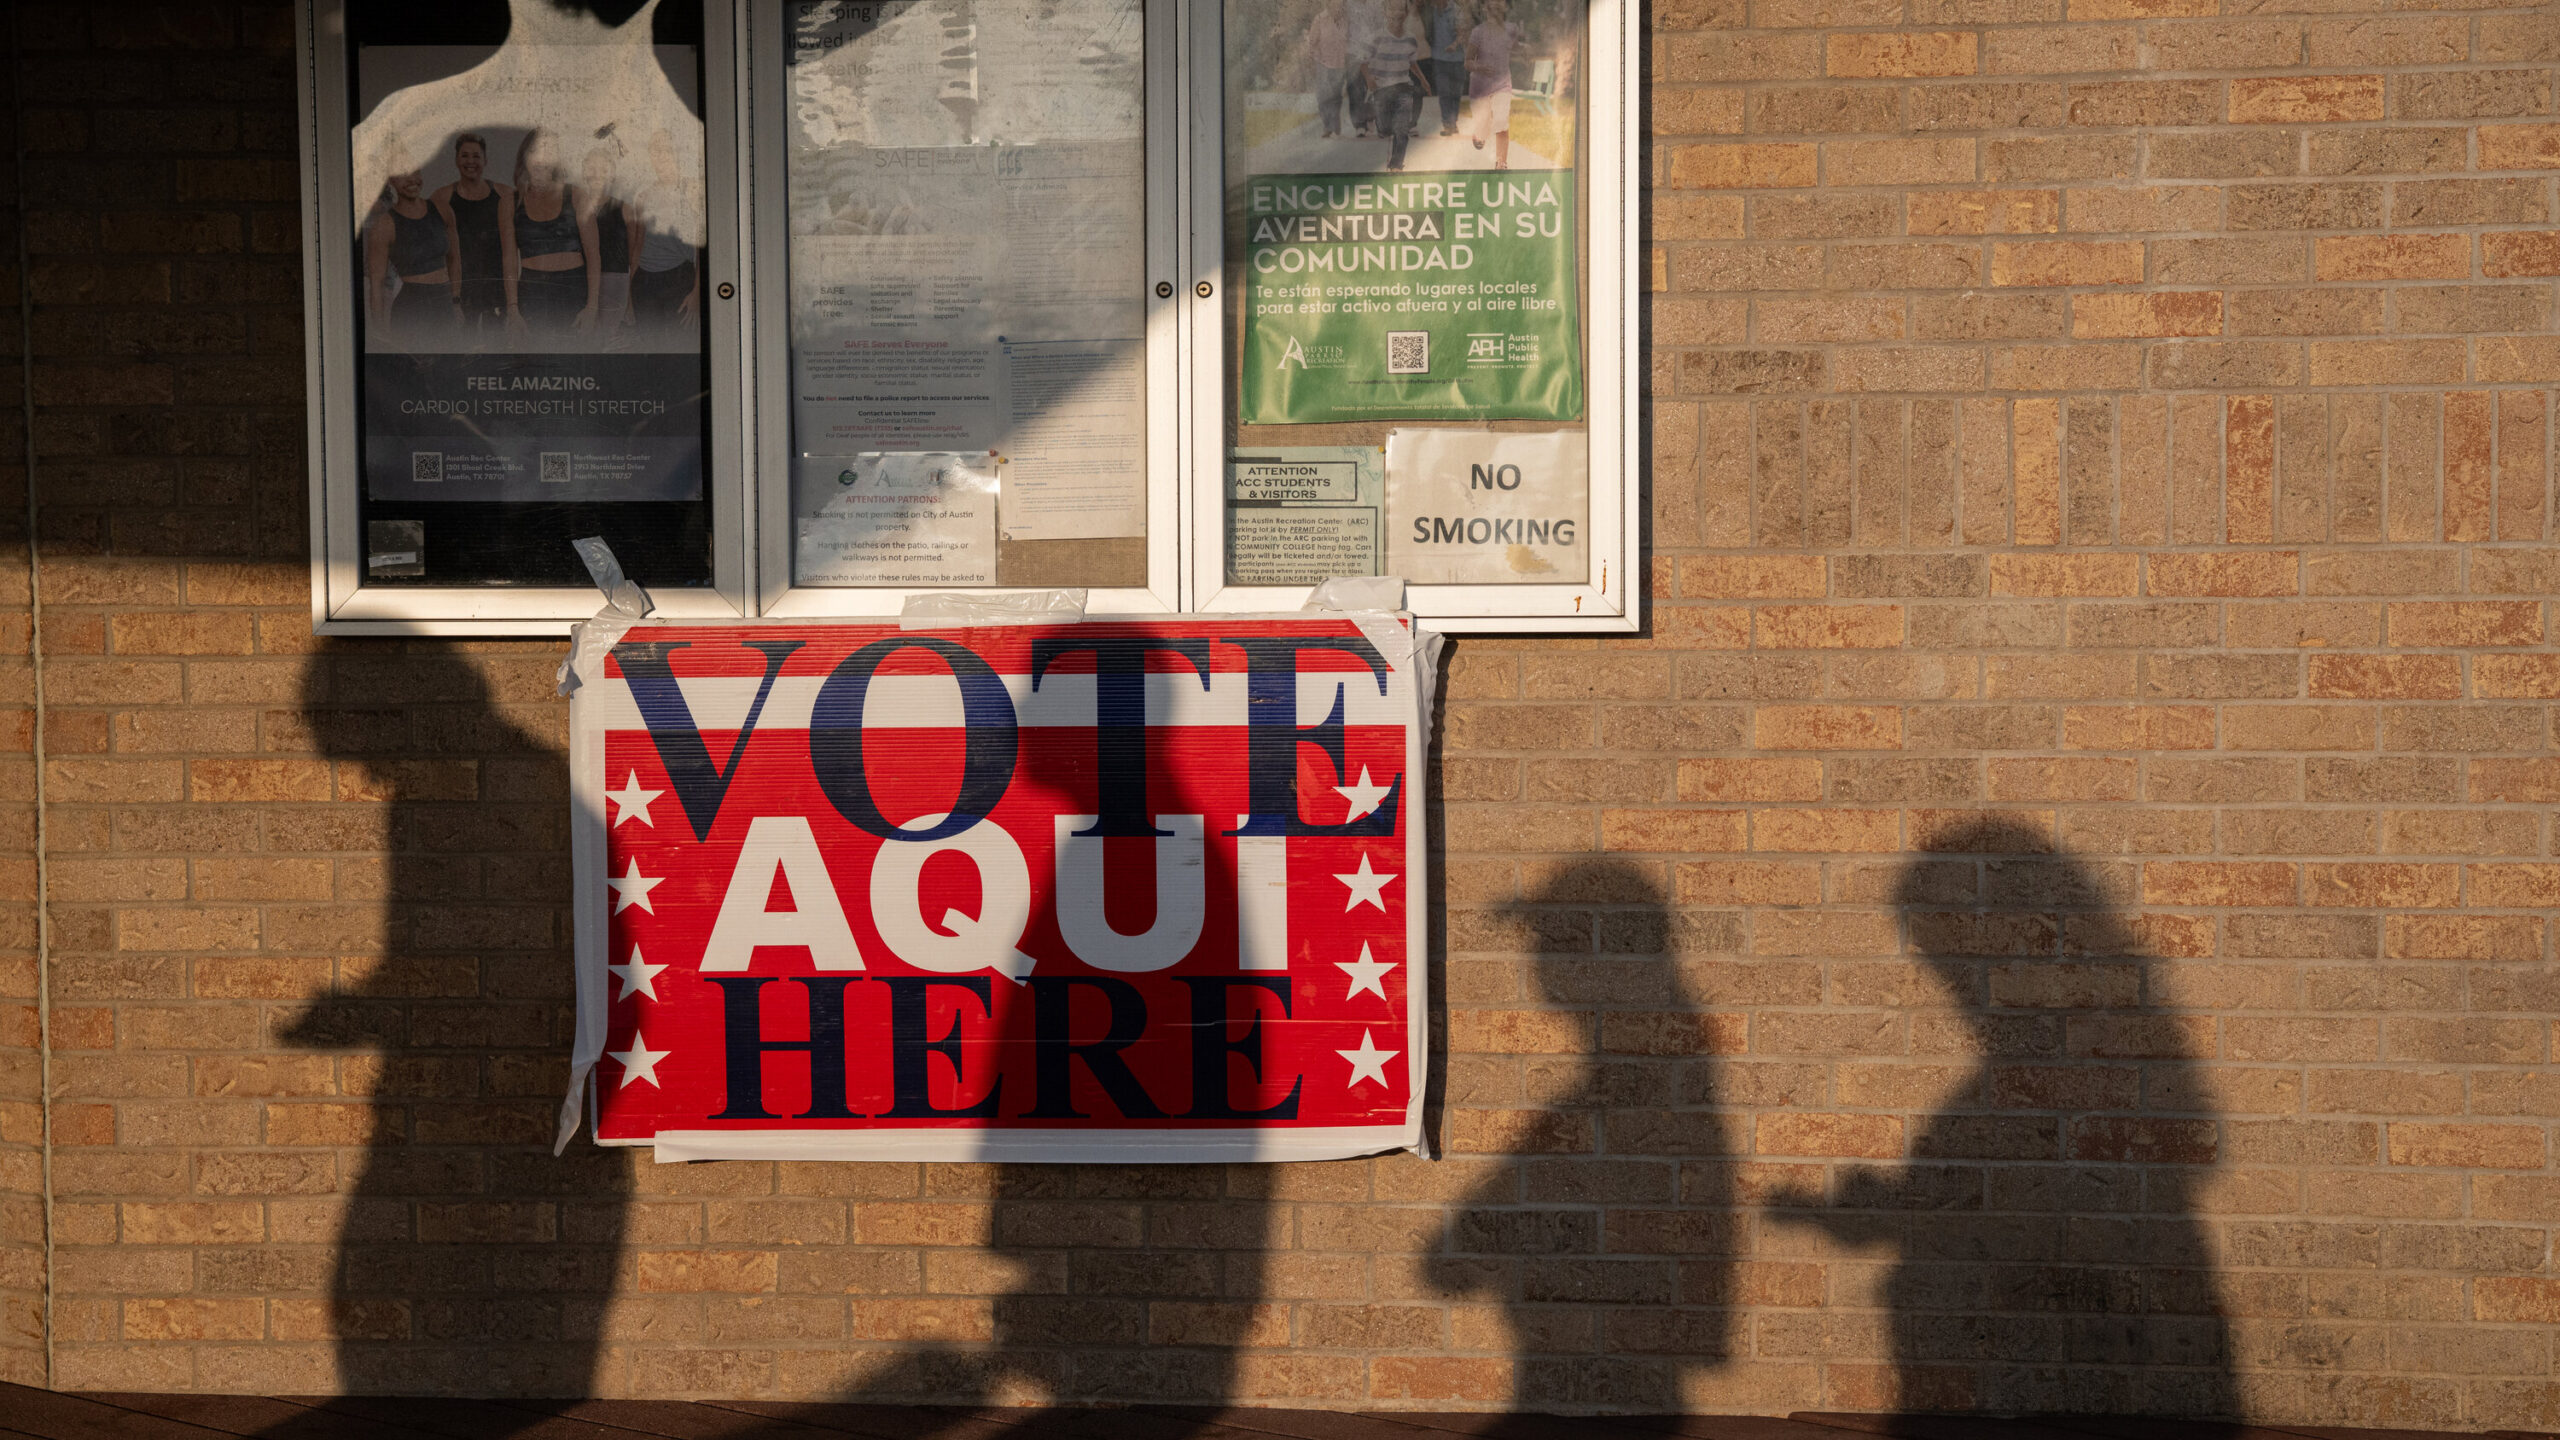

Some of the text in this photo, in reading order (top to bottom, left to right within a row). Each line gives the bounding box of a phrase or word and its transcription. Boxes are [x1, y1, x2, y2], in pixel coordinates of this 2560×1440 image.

[875, 151, 929, 168] SAFE
[1251, 181, 1559, 212] ENCUENTRE UNA
[1253, 211, 1562, 243] AVENTURA EN SU
[1253, 244, 1474, 274] COMUNIDAD
[1256, 281, 1537, 302] Te están esperando lugares locales
[812, 299, 853, 308] provides
[1257, 297, 1557, 317] para estar activo afuera y al aire libre
[1508, 333, 1539, 342] Austin
[844, 340, 948, 349] SAFE Serves Everyone
[1467, 339, 1504, 356] APH
[1508, 343, 1539, 352] Public
[1508, 353, 1539, 362] Health
[467, 376, 600, 391] FEEL AMAZING.
[803, 395, 815, 403] You
[816, 395, 825, 403] do
[838, 395, 855, 403] need
[856, 395, 863, 403] to
[863, 395, 874, 403] file
[880, 395, 900, 403] police
[901, 395, 921, 403] report
[922, 395, 929, 403] to
[930, 395, 950, 403] access
[951, 395, 963, 403] our
[400, 400, 665, 415] CARDIO STRENGTH STRETCH
[446, 454, 469, 462] Austin
[627, 463, 645, 471] Drive
[1248, 467, 1318, 476] ATTENTION
[473, 473, 483, 481] TX
[600, 472, 610, 480] TX
[1471, 463, 1522, 491] NO
[1235, 479, 1331, 487] ACC STUDENTS
[1249, 490, 1318, 499] & VISITORS
[845, 495, 942, 504] ATTENTION PATRONS:
[812, 511, 974, 520] Smoking is not permitted on City of Austin
[1237, 518, 1249, 526] the
[1251, 518, 1274, 526] Austin
[1276, 518, 1316, 526] Recreation
[1347, 518, 1369, 527] (ARC)
[875, 524, 911, 532] property.
[1228, 526, 1339, 534] parking lot is by PERMIT ONLY!
[1413, 517, 1576, 546] SMOKING
[1236, 535, 1369, 543] NOT park in the ARC parking lot with
[817, 541, 969, 551] Hanging clothes on the patio, railings or
[1235, 543, 1281, 552] COMMUNITY
[1282, 543, 1316, 552] COLLEGE
[1317, 543, 1336, 552] hang
[1355, 543, 1373, 552] Cars
[841, 553, 944, 562] walkways is not permitted.
[1257, 552, 1369, 560] will be ticketed and/or towed.
[832, 573, 849, 582] who
[850, 573, 877, 582] violate
[878, 573, 900, 582] these
[902, 573, 921, 582] rules
[922, 573, 939, 582] may
[941, 573, 951, 582] be
[952, 573, 975, 582] asked
[976, 573, 985, 582] to
[612, 636, 1402, 844] VOTE
[698, 813, 1288, 988] AQUI
[702, 974, 1303, 1122] HERE
